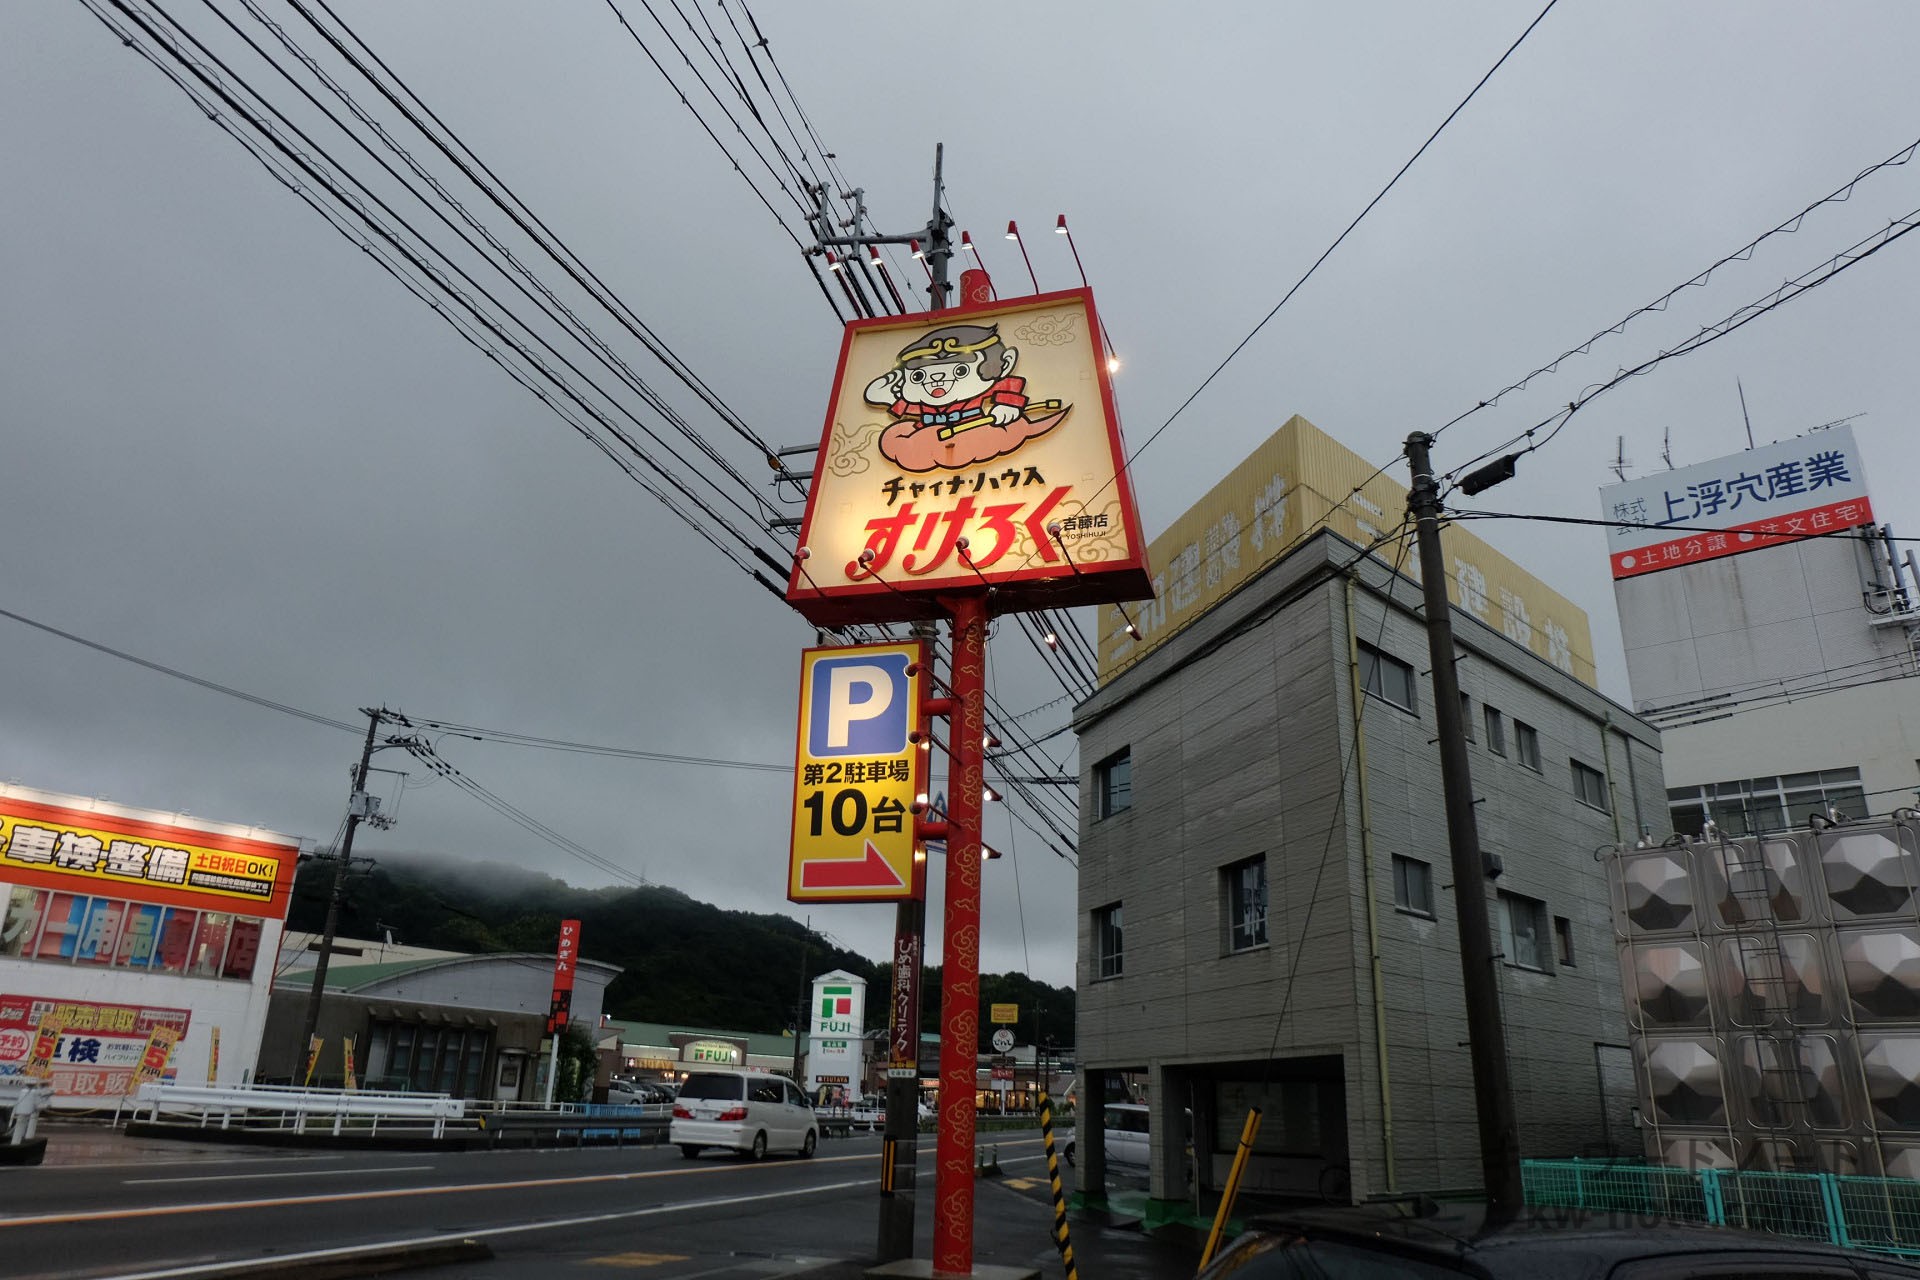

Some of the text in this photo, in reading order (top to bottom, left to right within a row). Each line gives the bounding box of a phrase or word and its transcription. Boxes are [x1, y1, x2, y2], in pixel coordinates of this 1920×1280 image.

[1655, 450, 1851, 525] 上浮穴産業
[1063, 513, 1108, 531] 吉藤店
[1613, 497, 1647, 519] 株式
[1760, 503, 1859, 541] 注文住宅
[844, 485, 1072, 581] すけろく
[1066, 531, 1106, 540] YOSHIHUJI
[1641, 534, 1728, 567] 土地分譲
[827, 665, 893, 748] P
[804, 759, 910, 786] 第2駐車場
[803, 788, 907, 837] 10台
[557, 926, 574, 971] ひめぎん
[896, 938, 913, 1052] ひめ歯科クリニック
[820, 1021, 851, 1033] FUJI
[35, 1036, 57, 1059] 5
[144, 1047, 169, 1069] 5
[705, 1049, 732, 1063] FUJI
